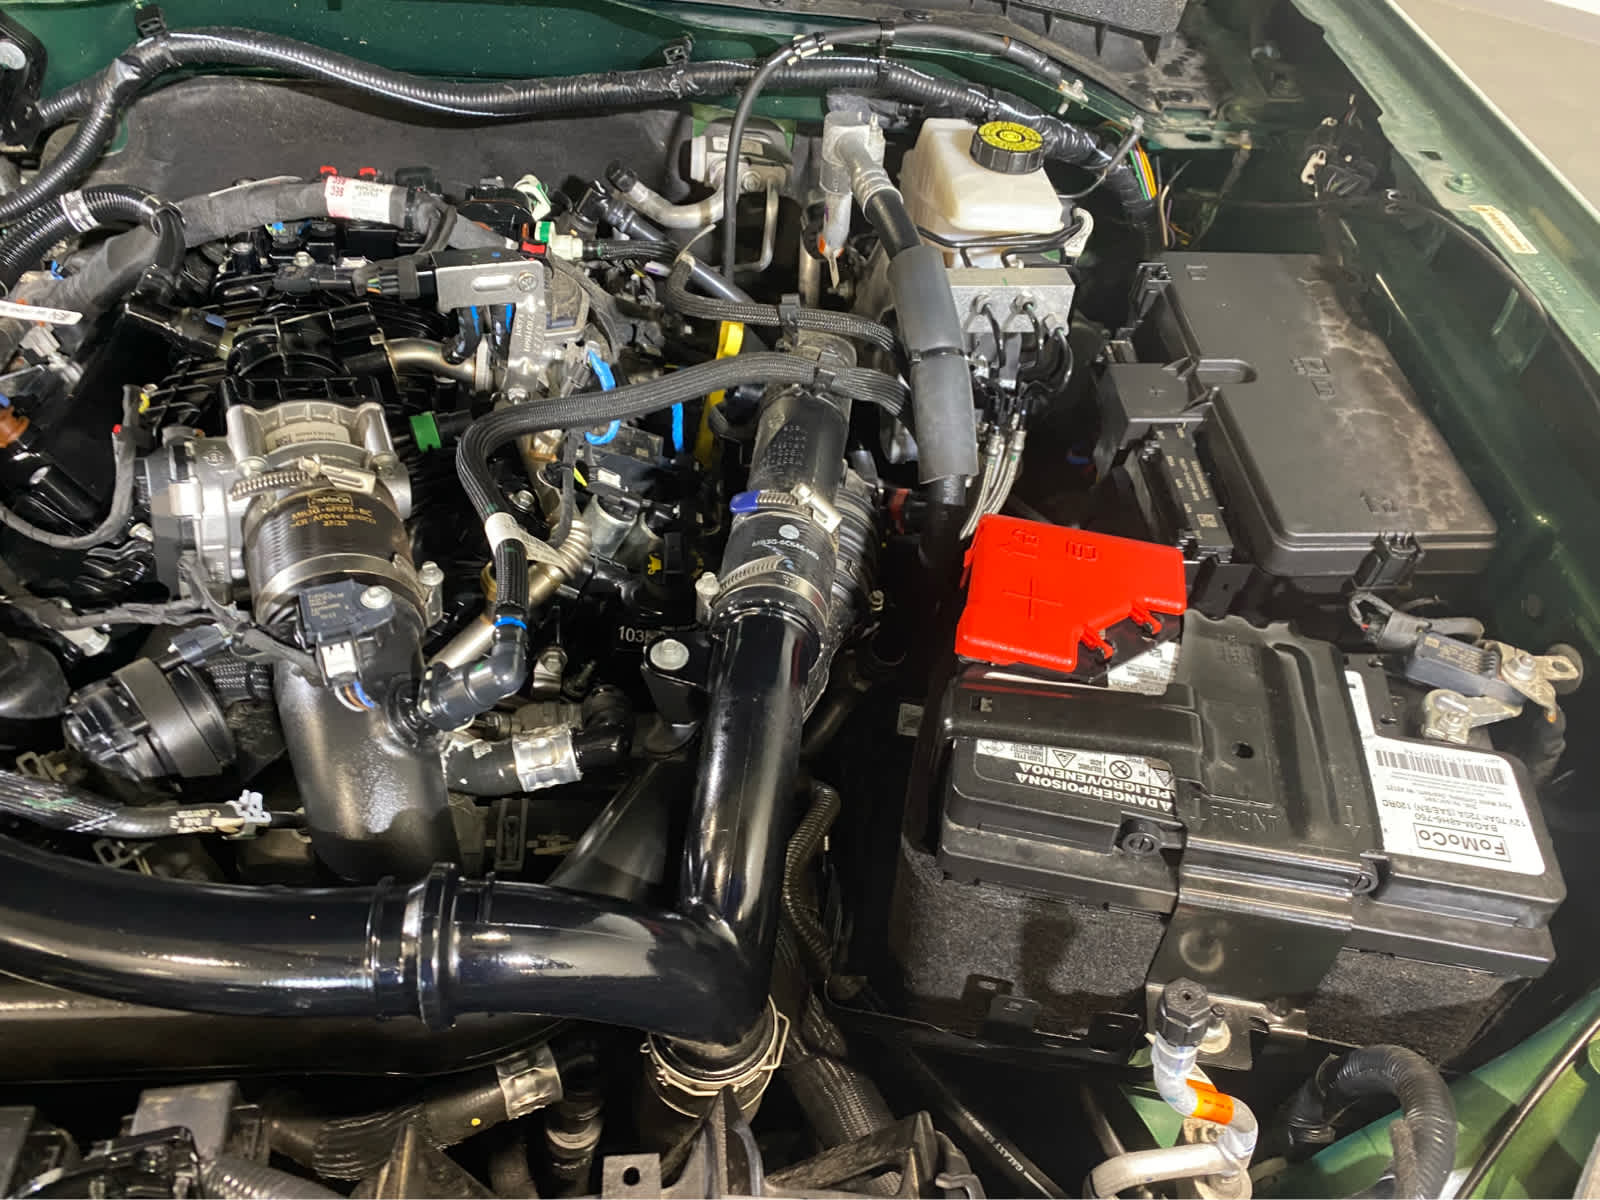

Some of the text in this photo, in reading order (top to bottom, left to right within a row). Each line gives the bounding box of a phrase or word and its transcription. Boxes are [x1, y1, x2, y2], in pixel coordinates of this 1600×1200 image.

[1028, 775, 1157, 808] DANGER/POISON
[1031, 764, 1170, 799] PELIGRO/VENENO
[1209, 805, 1280, 832] FRONT
[1418, 829, 1505, 855] FoMoCo
